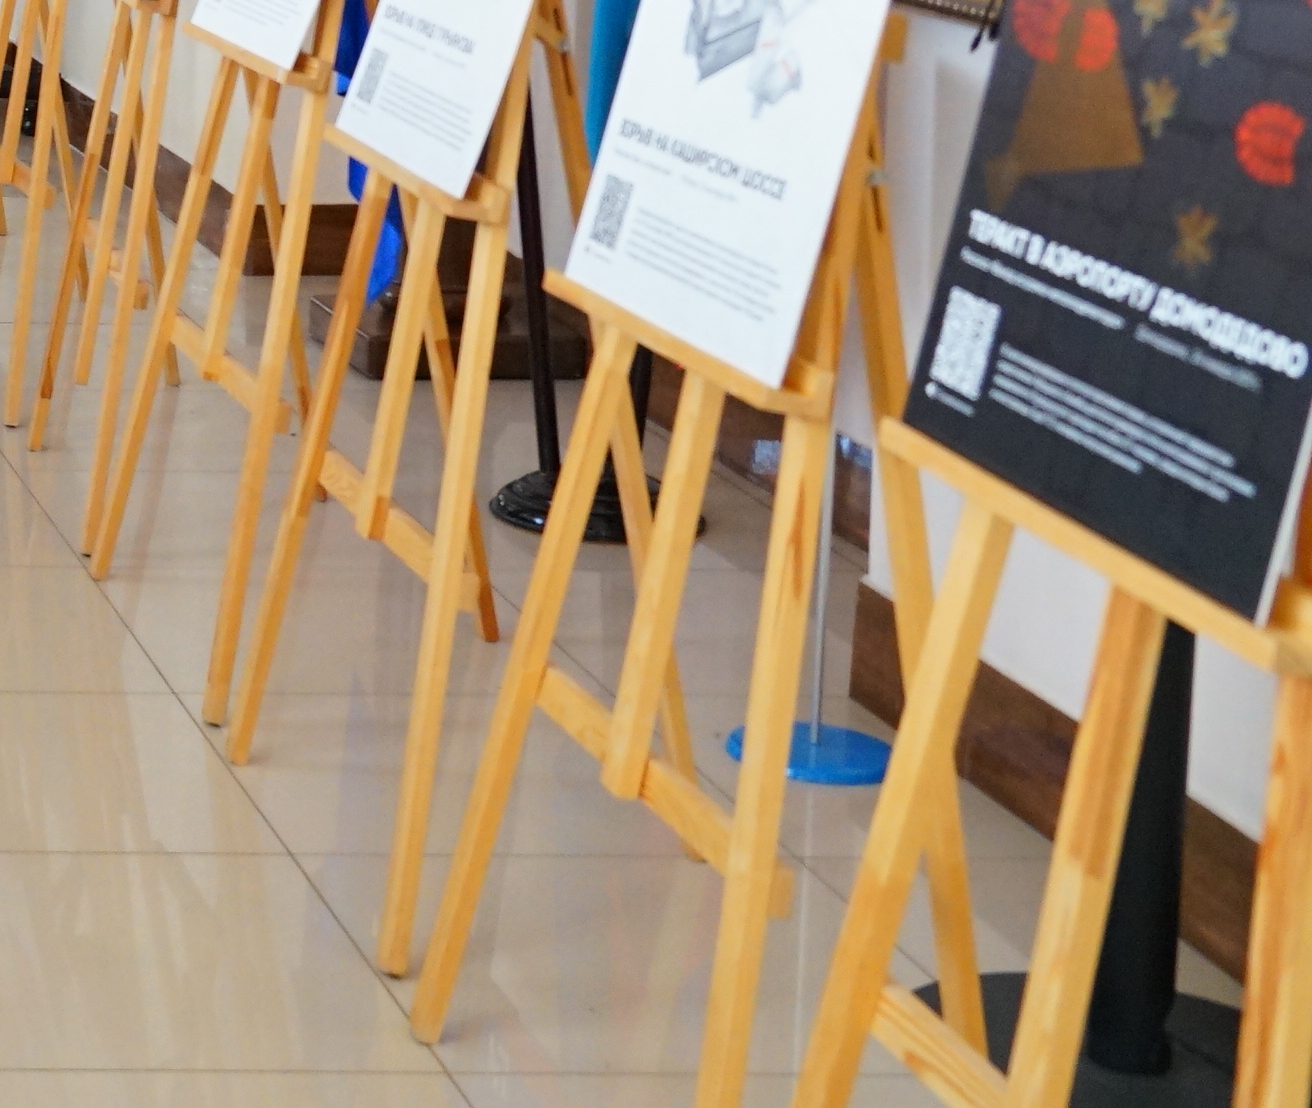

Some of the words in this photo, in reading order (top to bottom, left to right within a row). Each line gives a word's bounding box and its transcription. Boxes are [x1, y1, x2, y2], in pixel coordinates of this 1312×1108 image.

[968, 208, 1031, 259] ТЕРАКТ
[1027, 234, 1045, 266] В
[1041, 240, 1159, 311] АЭРОПОРТУ
[1149, 287, 1310, 380] ДОМОДЕДОВО
